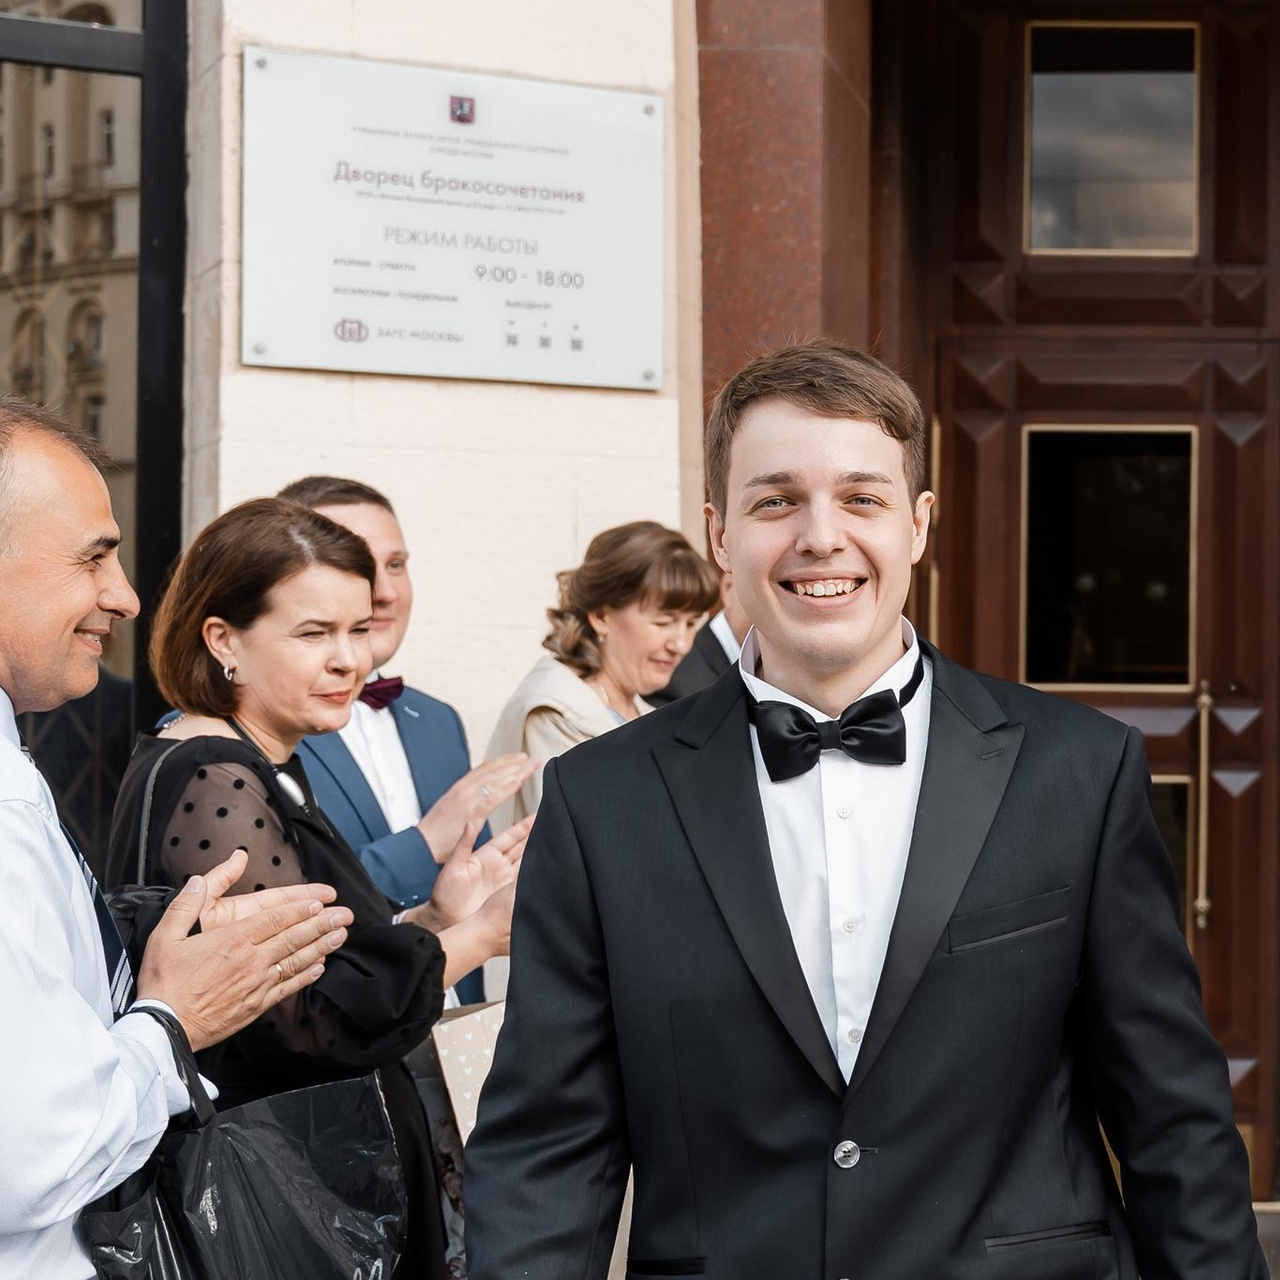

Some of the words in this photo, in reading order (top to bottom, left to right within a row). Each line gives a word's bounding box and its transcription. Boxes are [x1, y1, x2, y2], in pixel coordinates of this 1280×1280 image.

[333, 160, 415, 188] Дворец
[420, 169, 586, 204] бракосочетания
[383, 226, 458, 249] РЕЖИМ
[464, 233, 539, 256] РАБОТЫ
[474, 264, 517, 285] 9:00
[535, 268, 585, 290] 18:00
